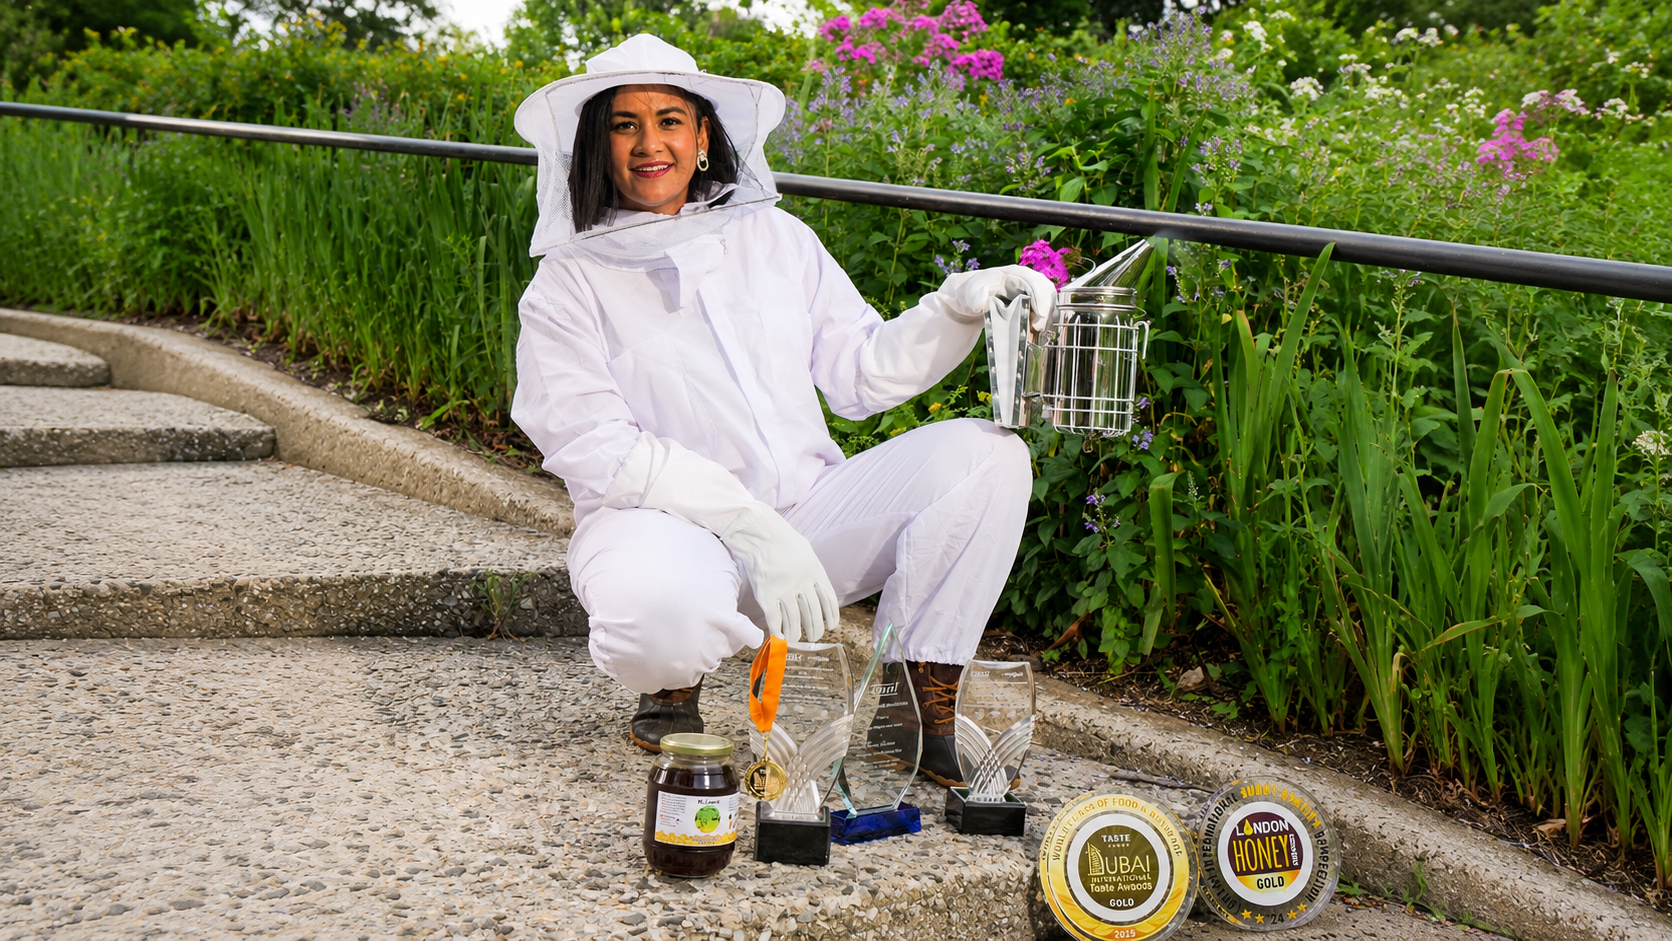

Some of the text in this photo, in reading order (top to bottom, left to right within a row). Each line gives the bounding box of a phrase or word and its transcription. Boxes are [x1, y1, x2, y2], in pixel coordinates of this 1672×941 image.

[1097, 798, 1109, 808] OF
[1112, 798, 1139, 810] FOOD
[1101, 833, 1131, 843] TASTE
[1232, 833, 1290, 873] HONEY
[1256, 876, 1285, 890] GOLD
[1109, 897, 1135, 908] GOLD
